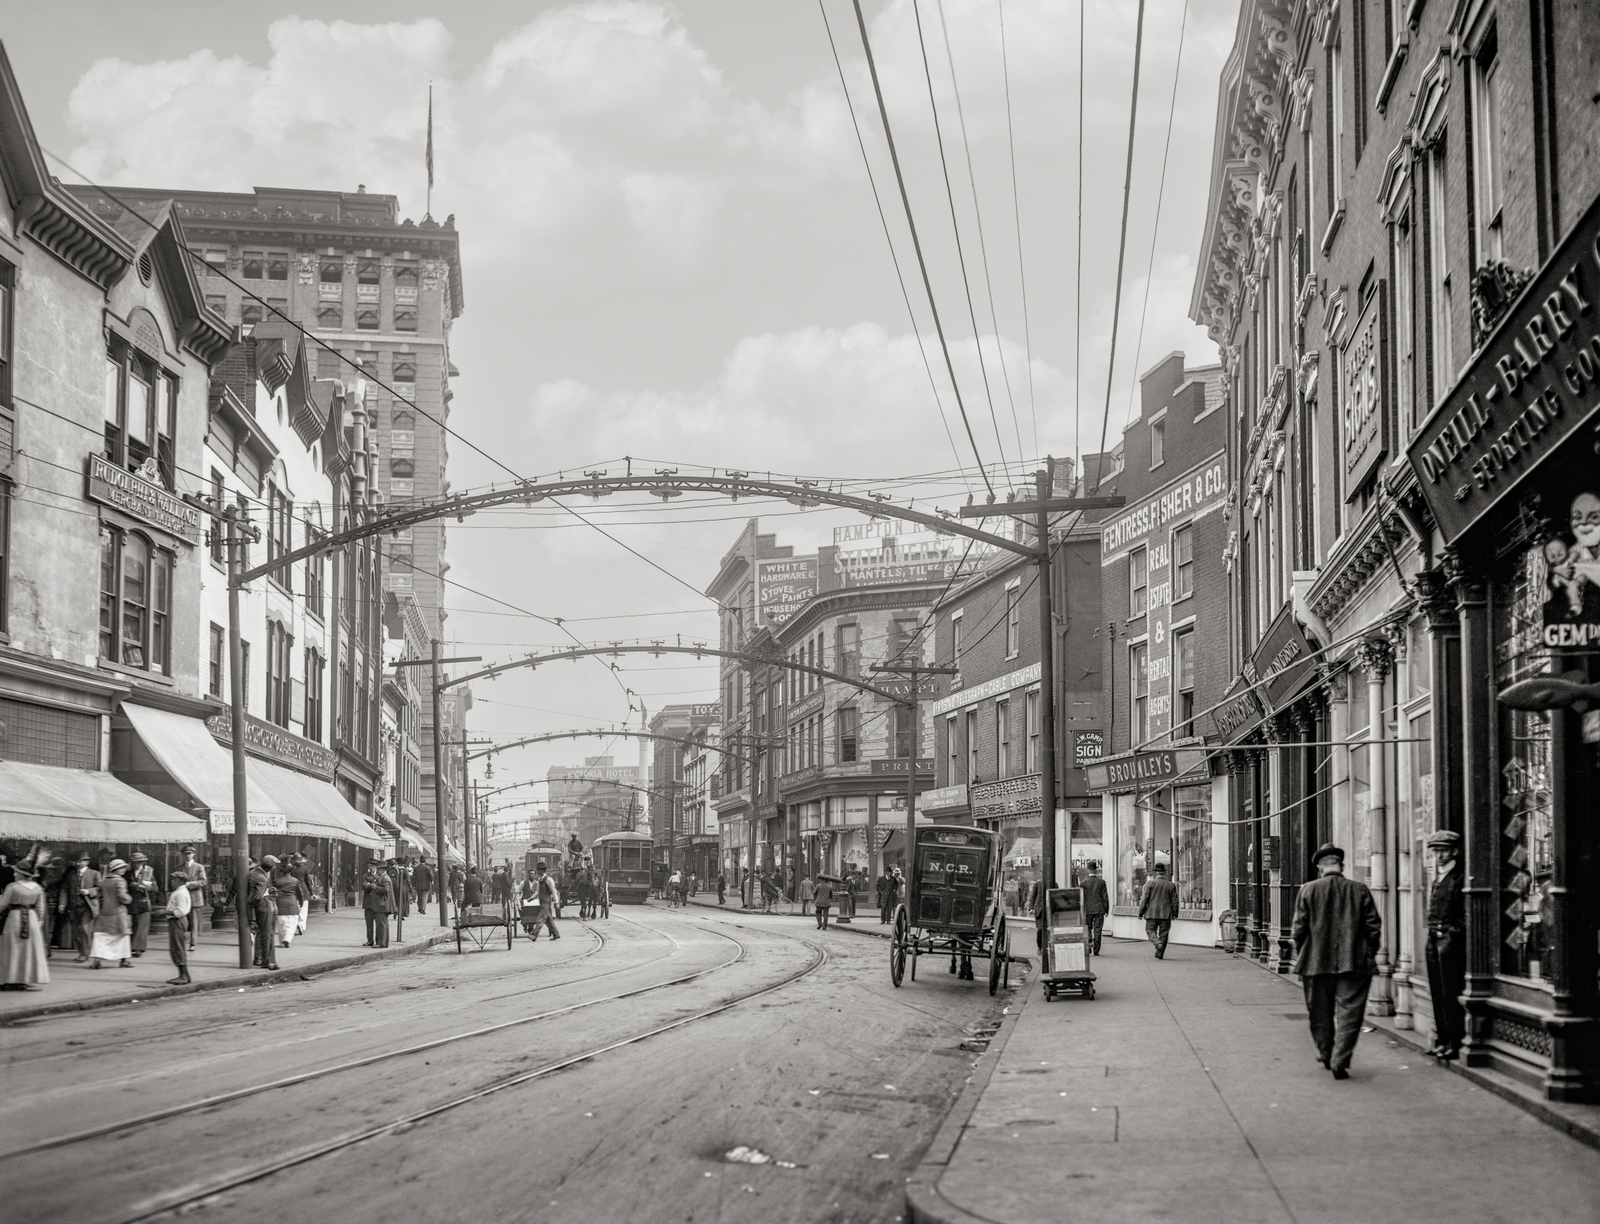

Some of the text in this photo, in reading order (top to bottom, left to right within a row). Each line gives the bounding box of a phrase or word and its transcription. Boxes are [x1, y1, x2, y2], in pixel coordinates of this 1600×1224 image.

[1472, 334, 1600, 489] SPORTING GOO
[94, 460, 199, 527] RUDOLPHI & WALLACE
[107, 486, 153, 519] MERCHANT
[1150, 481, 1193, 531] FISHER
[1195, 475, 1203, 504] &
[1205, 464, 1227, 498] CO.
[833, 519, 903, 541] HAMPTON
[766, 562, 808, 574] WHITE
[833, 540, 944, 575] STATIONERS
[1150, 543, 1169, 572] REAL
[760, 571, 808, 583] HARDWARE
[849, 568, 906, 581] MANTELS,
[1150, 581, 1170, 610] ESTATE
[1155, 620, 1165, 644] &
[1544, 623, 1588, 647] GEM
[1011, 663, 1041, 688] COMPANY
[1150, 655, 1170, 682] RENTAL
[1150, 694, 1170, 717] AGENTS
[1076, 745, 1102, 757] SIGN
[567, 769, 634, 778] VICTORIA HOTEL
[881, 762, 934, 771] PRINT
[214, 814, 235, 828] RUDOL
